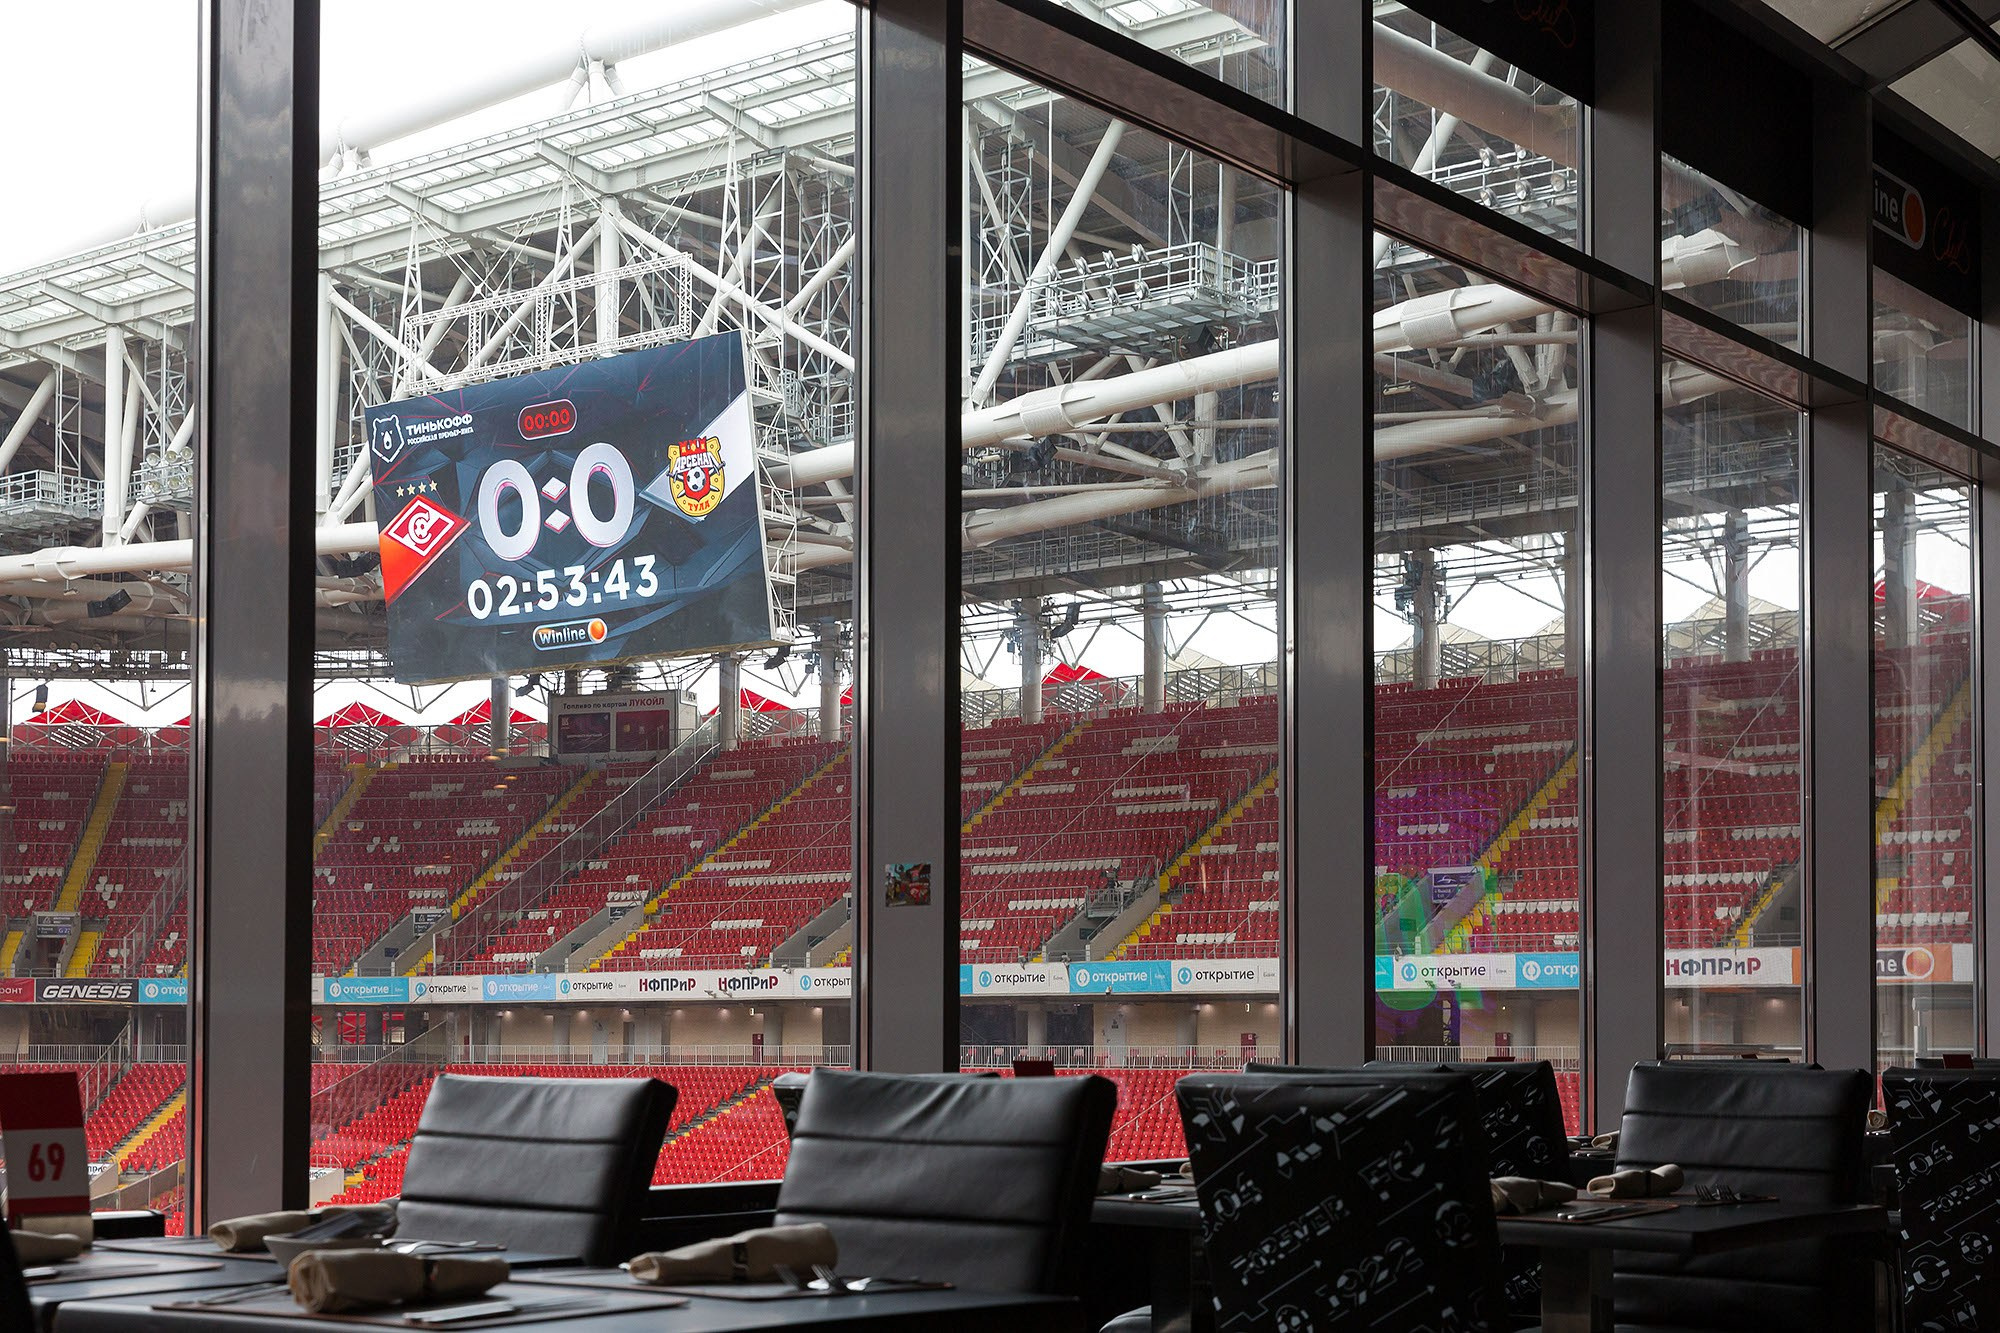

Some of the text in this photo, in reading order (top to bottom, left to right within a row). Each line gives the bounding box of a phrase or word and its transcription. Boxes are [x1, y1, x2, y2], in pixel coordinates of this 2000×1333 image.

[405, 413, 473, 436] ТИНЬКОФФ
[523, 408, 570, 431] 00:00
[673, 451, 720, 473] АРСЕНАЛ
[477, 442, 635, 562] 0:0
[687, 499, 711, 512] ТУЛА
[467, 554, 659, 619] 02:53:43
[538, 627, 586, 645] Winline
[628, 696, 665, 707] ЛУКОЙЛ
[994, 973, 1046, 985] открытие
[1092, 971, 1148, 985] открытие
[1195, 970, 1255, 983] открытие
[1421, 965, 1486, 979] открытие
[42, 985, 133, 999] GENESIS
[343, 985, 389, 996] открытие
[428, 984, 467, 995] открытие
[498, 983, 539, 994] открытие
[572, 981, 613, 992] открытие
[27, 1142, 65, 1182] 69
